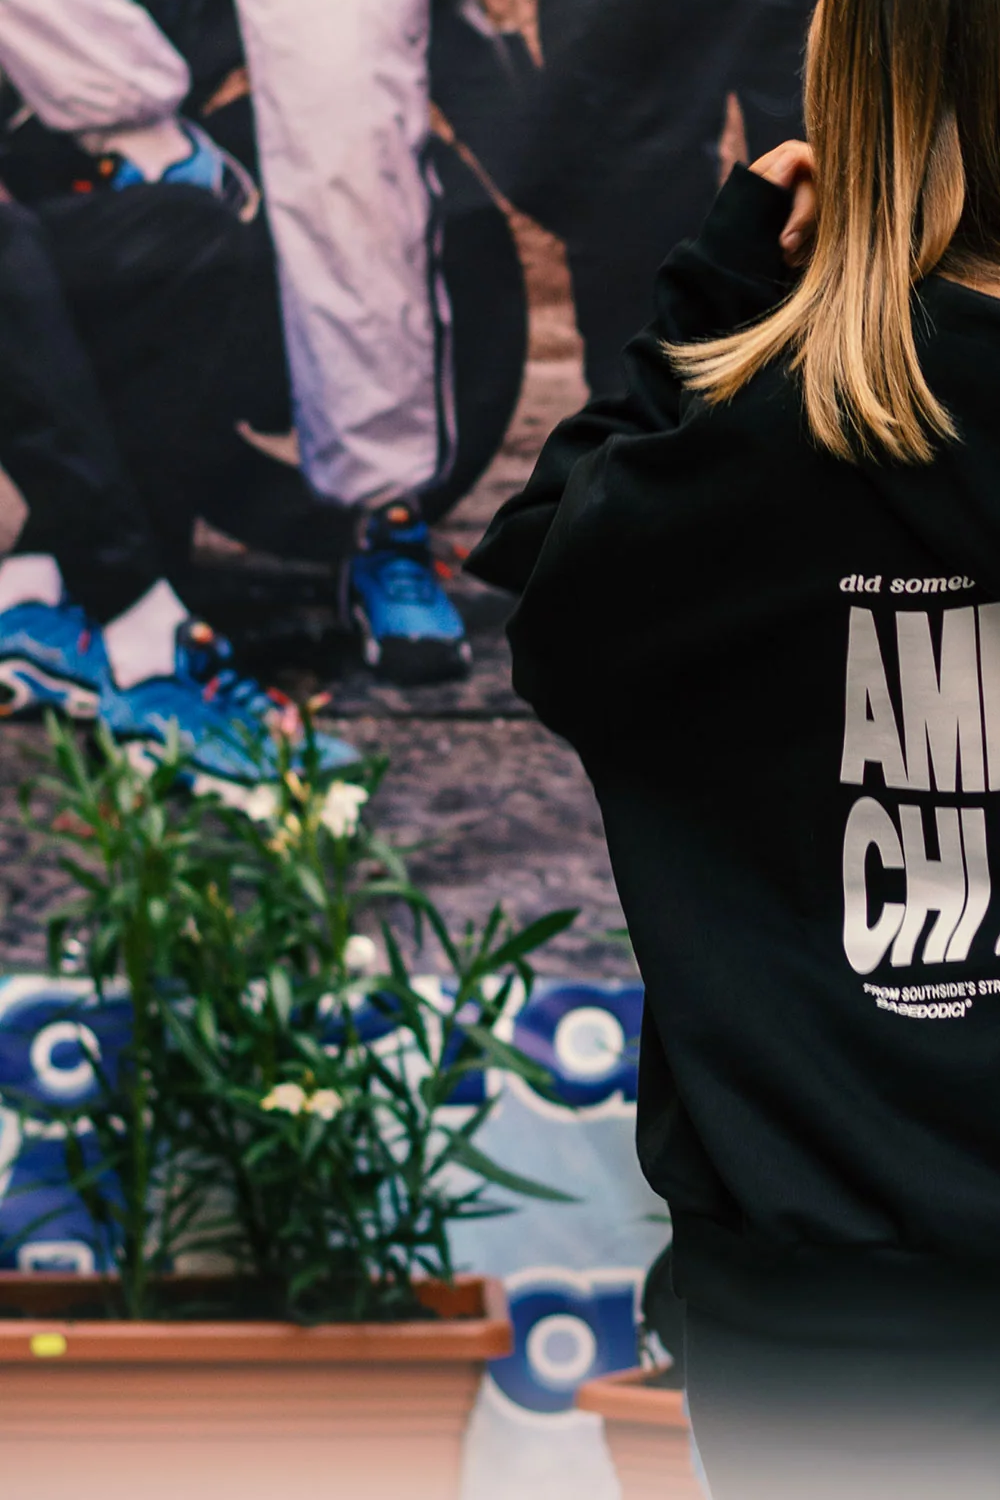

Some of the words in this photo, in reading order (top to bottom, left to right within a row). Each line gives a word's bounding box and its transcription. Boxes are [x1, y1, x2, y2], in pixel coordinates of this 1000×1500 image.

[840, 574, 882, 593] did
[842, 796, 991, 975] CHI
[862, 982, 900, 1002] FROM
[901, 980, 977, 1002] SOUTHSIDE'S
